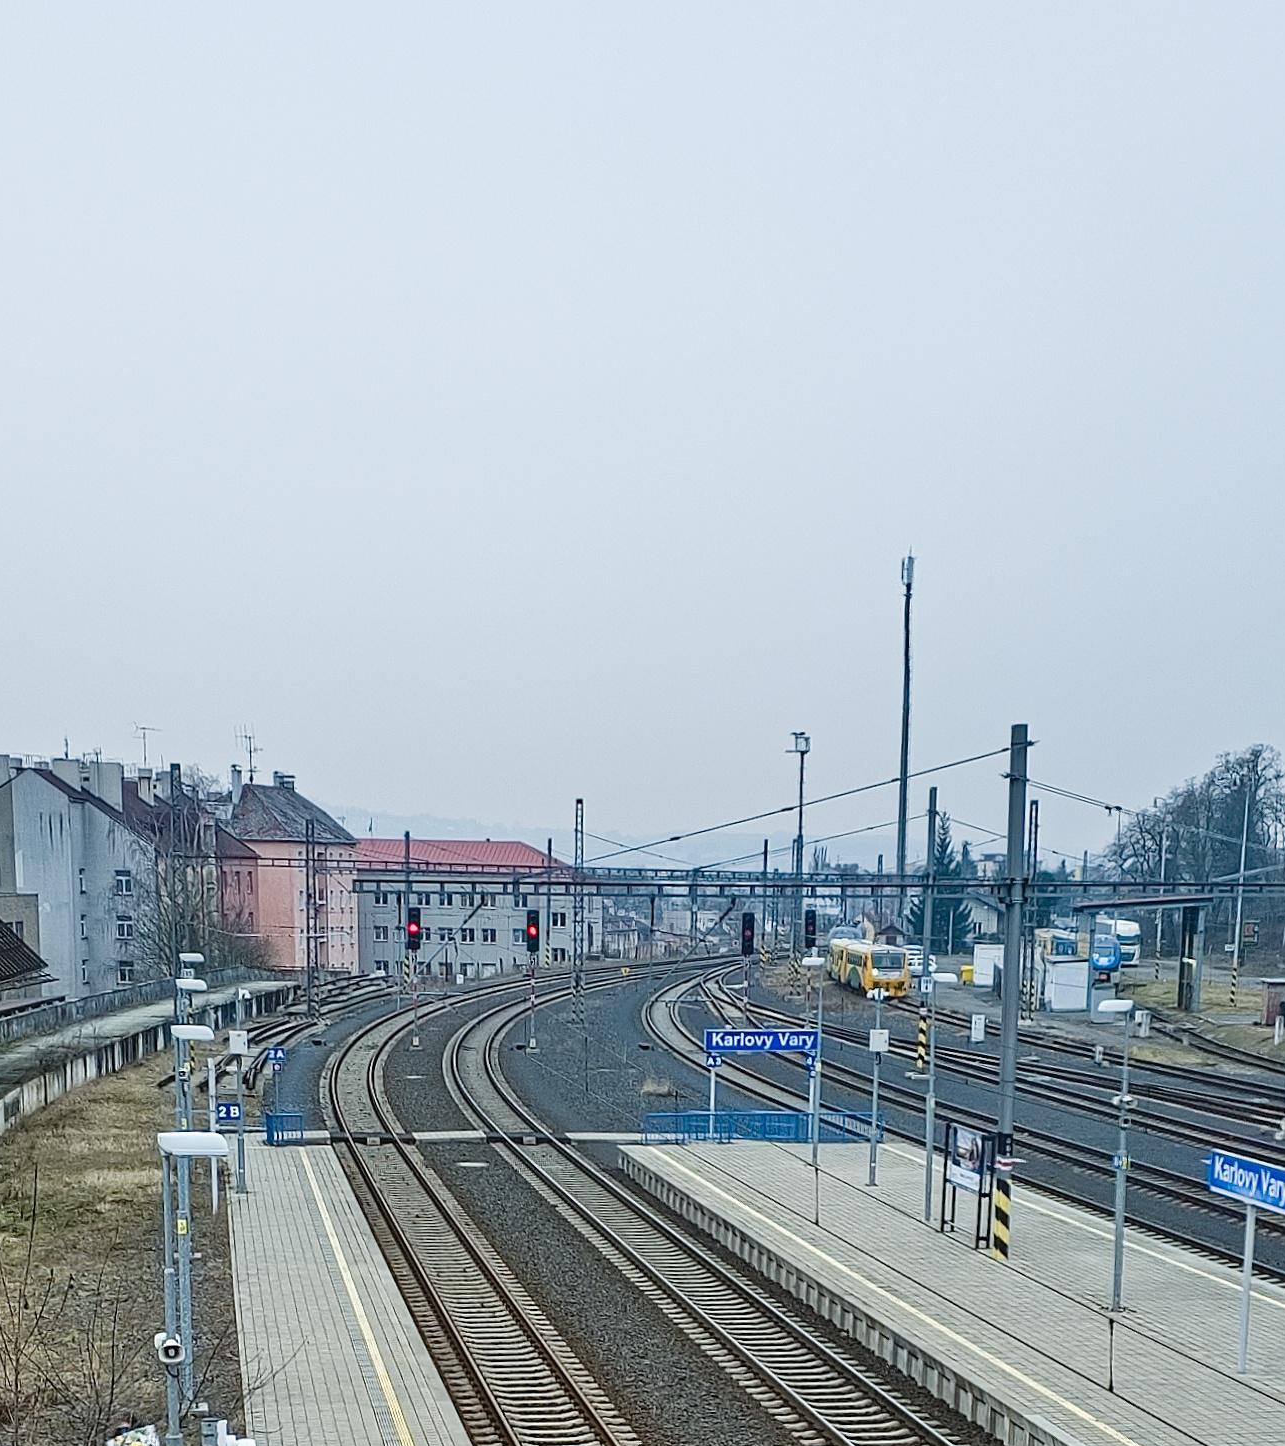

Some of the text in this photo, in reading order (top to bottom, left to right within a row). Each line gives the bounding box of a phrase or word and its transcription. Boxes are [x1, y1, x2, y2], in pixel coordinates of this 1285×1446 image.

[712, 1033, 815, 1049] Karlovy Vary
[1215, 1155, 1259, 1196] Karlovy
